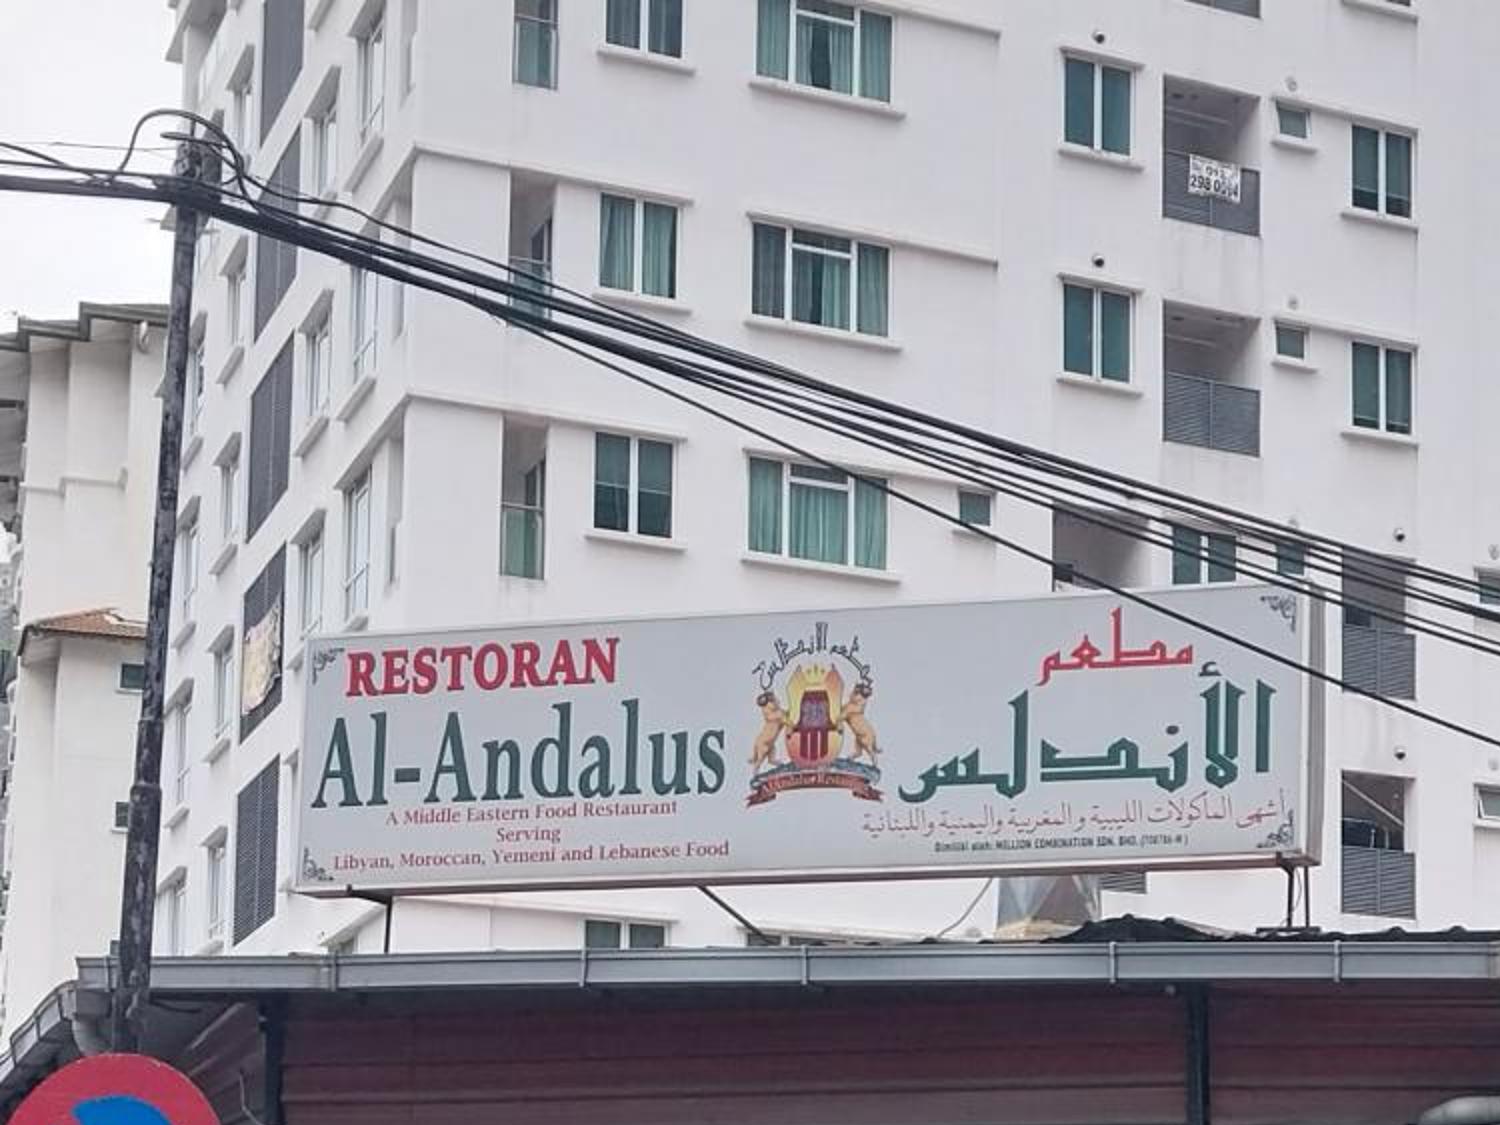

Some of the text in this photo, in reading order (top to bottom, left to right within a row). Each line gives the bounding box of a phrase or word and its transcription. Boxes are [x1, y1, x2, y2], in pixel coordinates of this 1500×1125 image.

[346, 638, 620, 697] RESTORAN
[1035, 607, 1194, 687] مطعم
[311, 698, 725, 808] Al-Andalus
[898, 661, 1277, 803] الأندلس
[386, 800, 677, 825] A Middle Eastern Food Restaurant
[496, 827, 561, 843] Serving
[334, 839, 729, 872] Libyan, Moroccan, Yemeni and Lebanese Food
